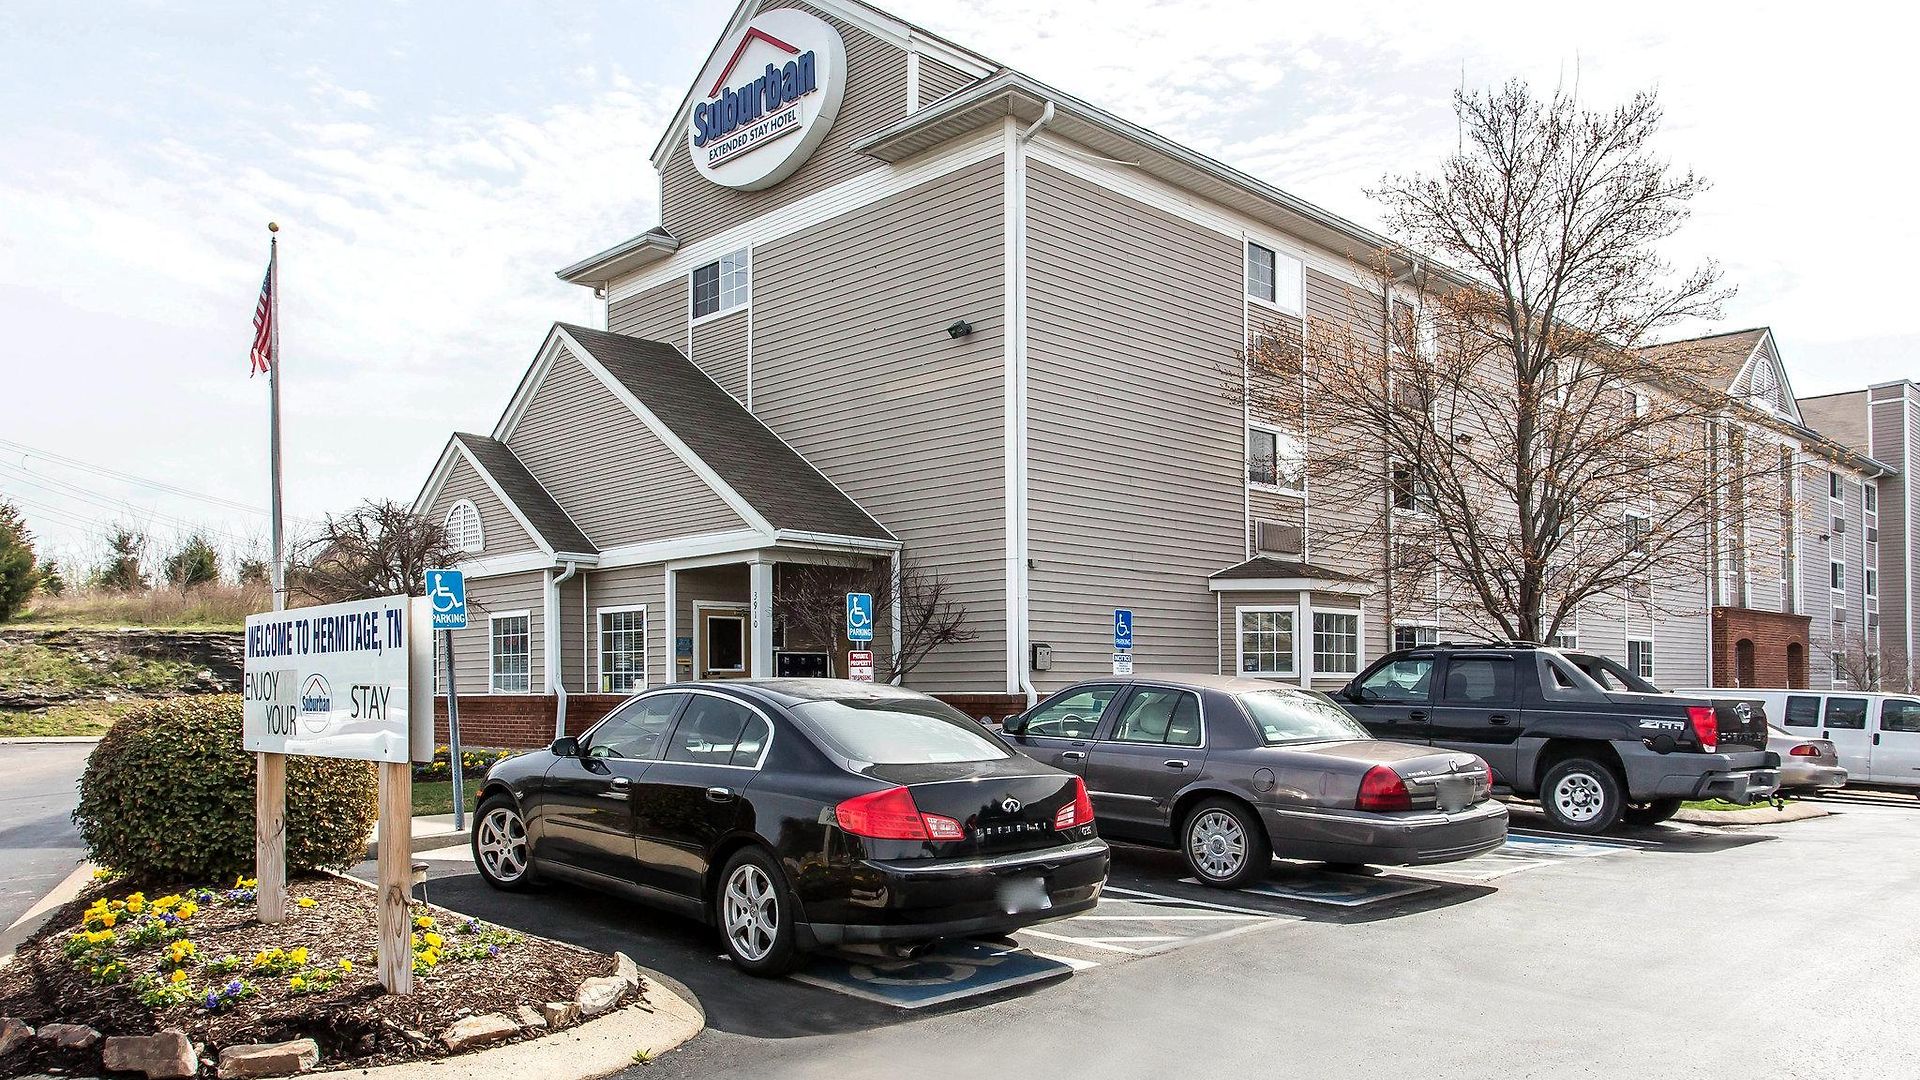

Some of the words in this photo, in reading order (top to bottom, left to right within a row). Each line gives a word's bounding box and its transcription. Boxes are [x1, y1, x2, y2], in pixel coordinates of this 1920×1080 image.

[694, 50, 816, 148] Suburban
[709, 134, 748, 161] EXTENDED
[750, 123, 768, 141] STAY
[770, 110, 797, 132] HOTEL
[248, 620, 293, 658] WELCOME
[296, 619, 310, 655] TO
[313, 610, 383, 657] HERMITAGE,
[386, 608, 402, 649] TN
[432, 613, 465, 624] PARKING
[849, 628, 871, 636] PARKING
[245, 671, 280, 701] ENJOY
[302, 695, 330, 712] Suburban
[350, 684, 391, 721] STAY
[265, 705, 297, 736] YOUR
